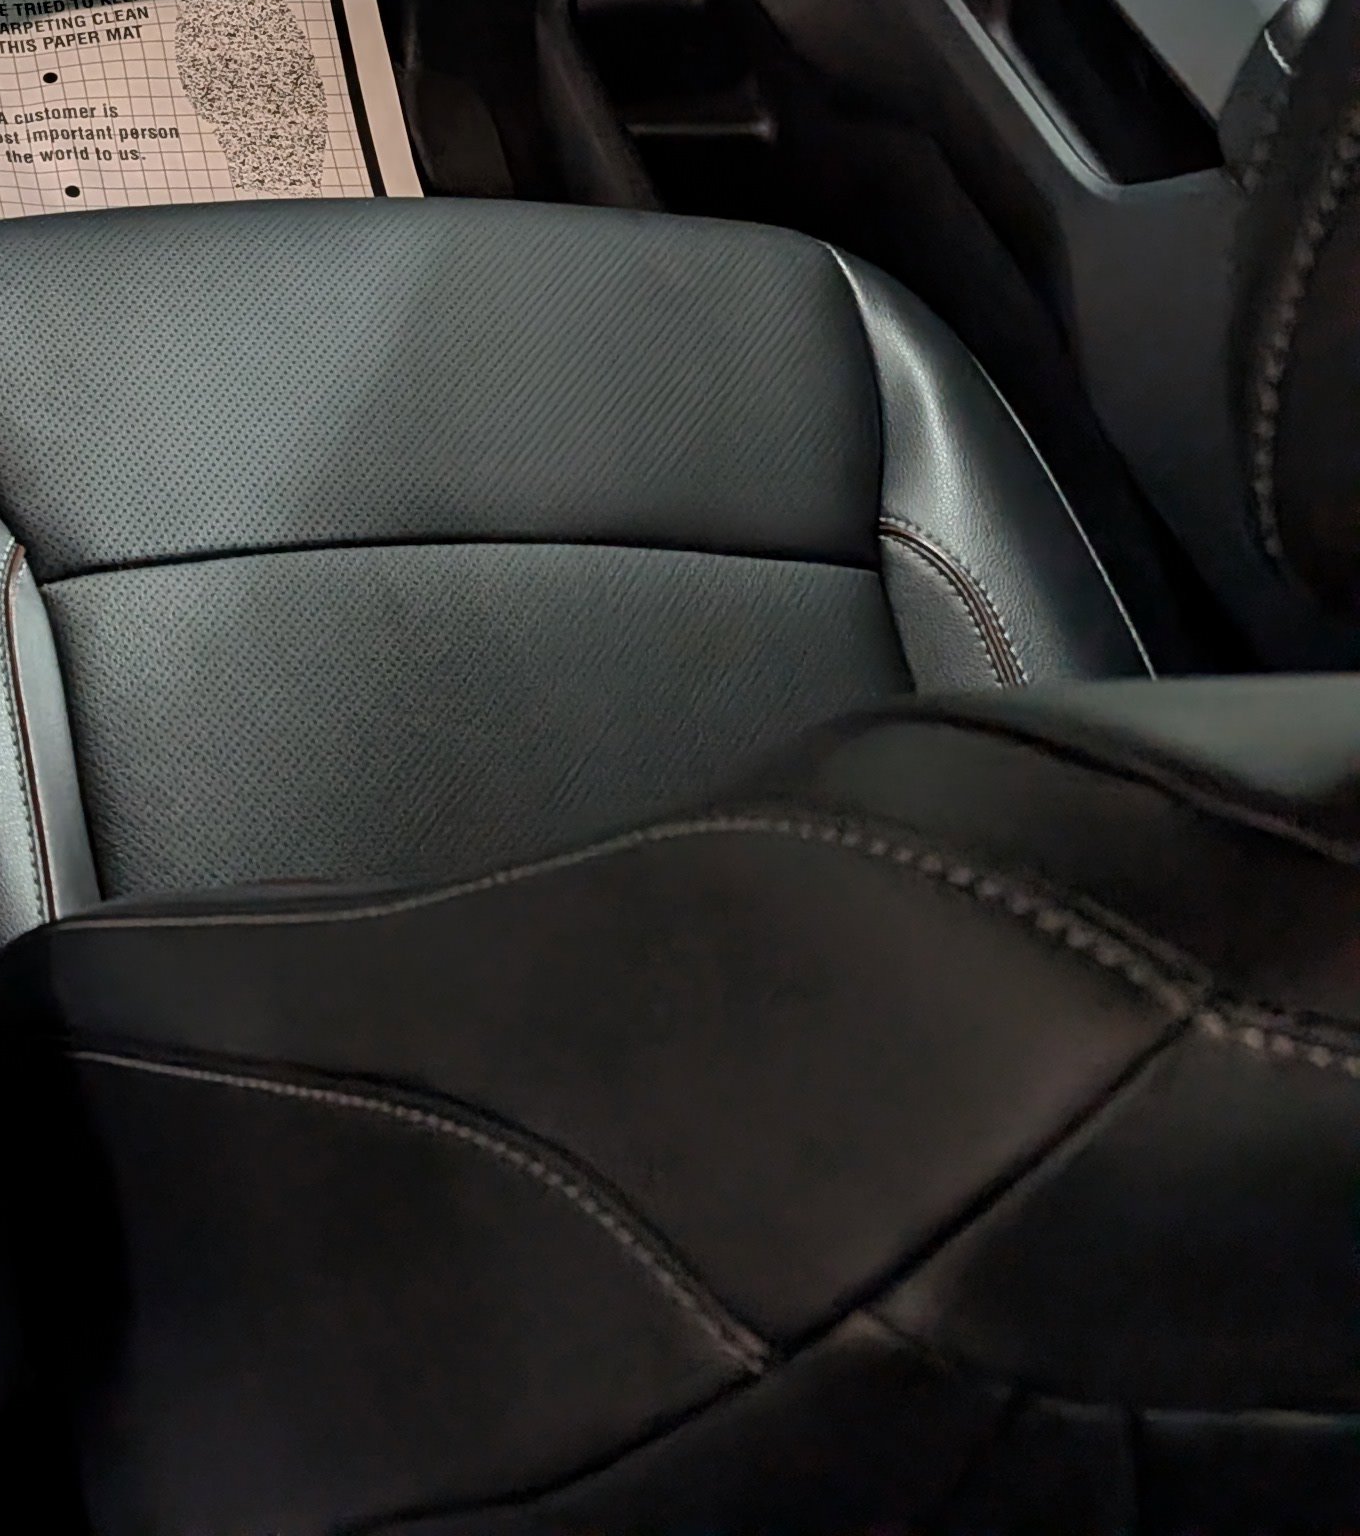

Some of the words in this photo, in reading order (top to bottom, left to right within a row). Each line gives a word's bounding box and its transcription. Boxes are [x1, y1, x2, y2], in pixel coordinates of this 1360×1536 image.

[13, 0, 65, 17] TRIED
[92, 6, 150, 25] CLEAN
[43, 32, 100, 50] PAPER
[106, 25, 143, 41] MAT
[14, 105, 96, 125] customer
[103, 103, 119, 118] is
[27, 125, 113, 143] important
[119, 126, 180, 143] person
[6, 150, 33, 164] the
[39, 146, 89, 163] world
[95, 148, 113, 161] to
[119, 149, 146, 161] us.
